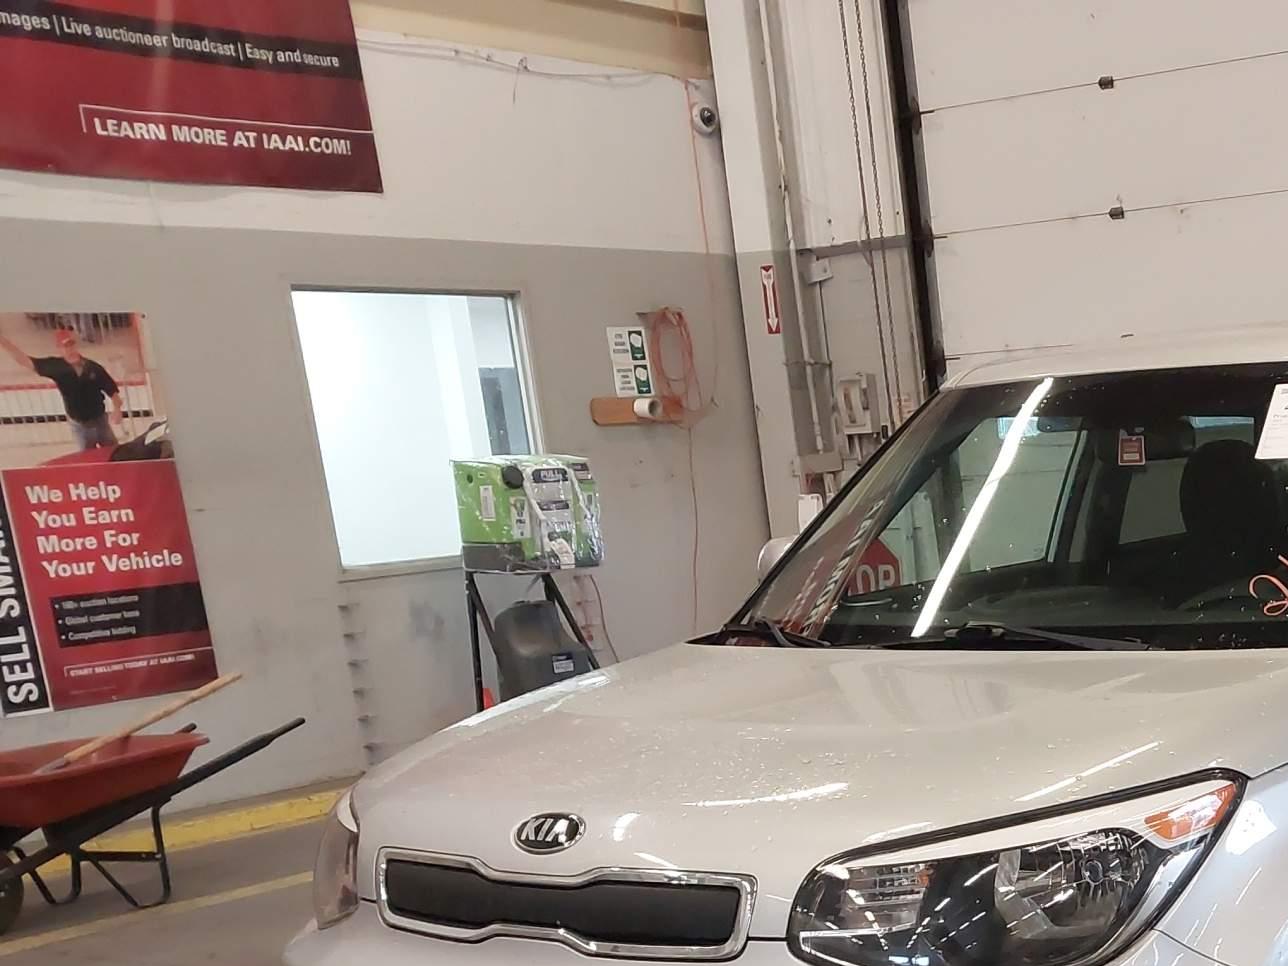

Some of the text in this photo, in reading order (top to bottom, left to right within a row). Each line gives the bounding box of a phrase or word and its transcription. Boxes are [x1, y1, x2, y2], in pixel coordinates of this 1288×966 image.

[61, 16, 92, 36] Live
[94, 25, 169, 47] auctioneer
[171, 32, 236, 56] broadcast
[245, 43, 274, 64] Easy
[276, 48, 302, 62] and
[303, 53, 340, 67] secure
[94, 117, 352, 155] LEARN MORE AT IAAI.COM!
[25, 481, 121, 504] We Help
[31, 507, 135, 529] You Earn
[36, 529, 141, 554] More For
[41, 549, 183, 578] Your Vehicle
[856, 563, 896, 593] OP
[0, 626, 39, 704] SELL
[520, 817, 570, 843] KIA
